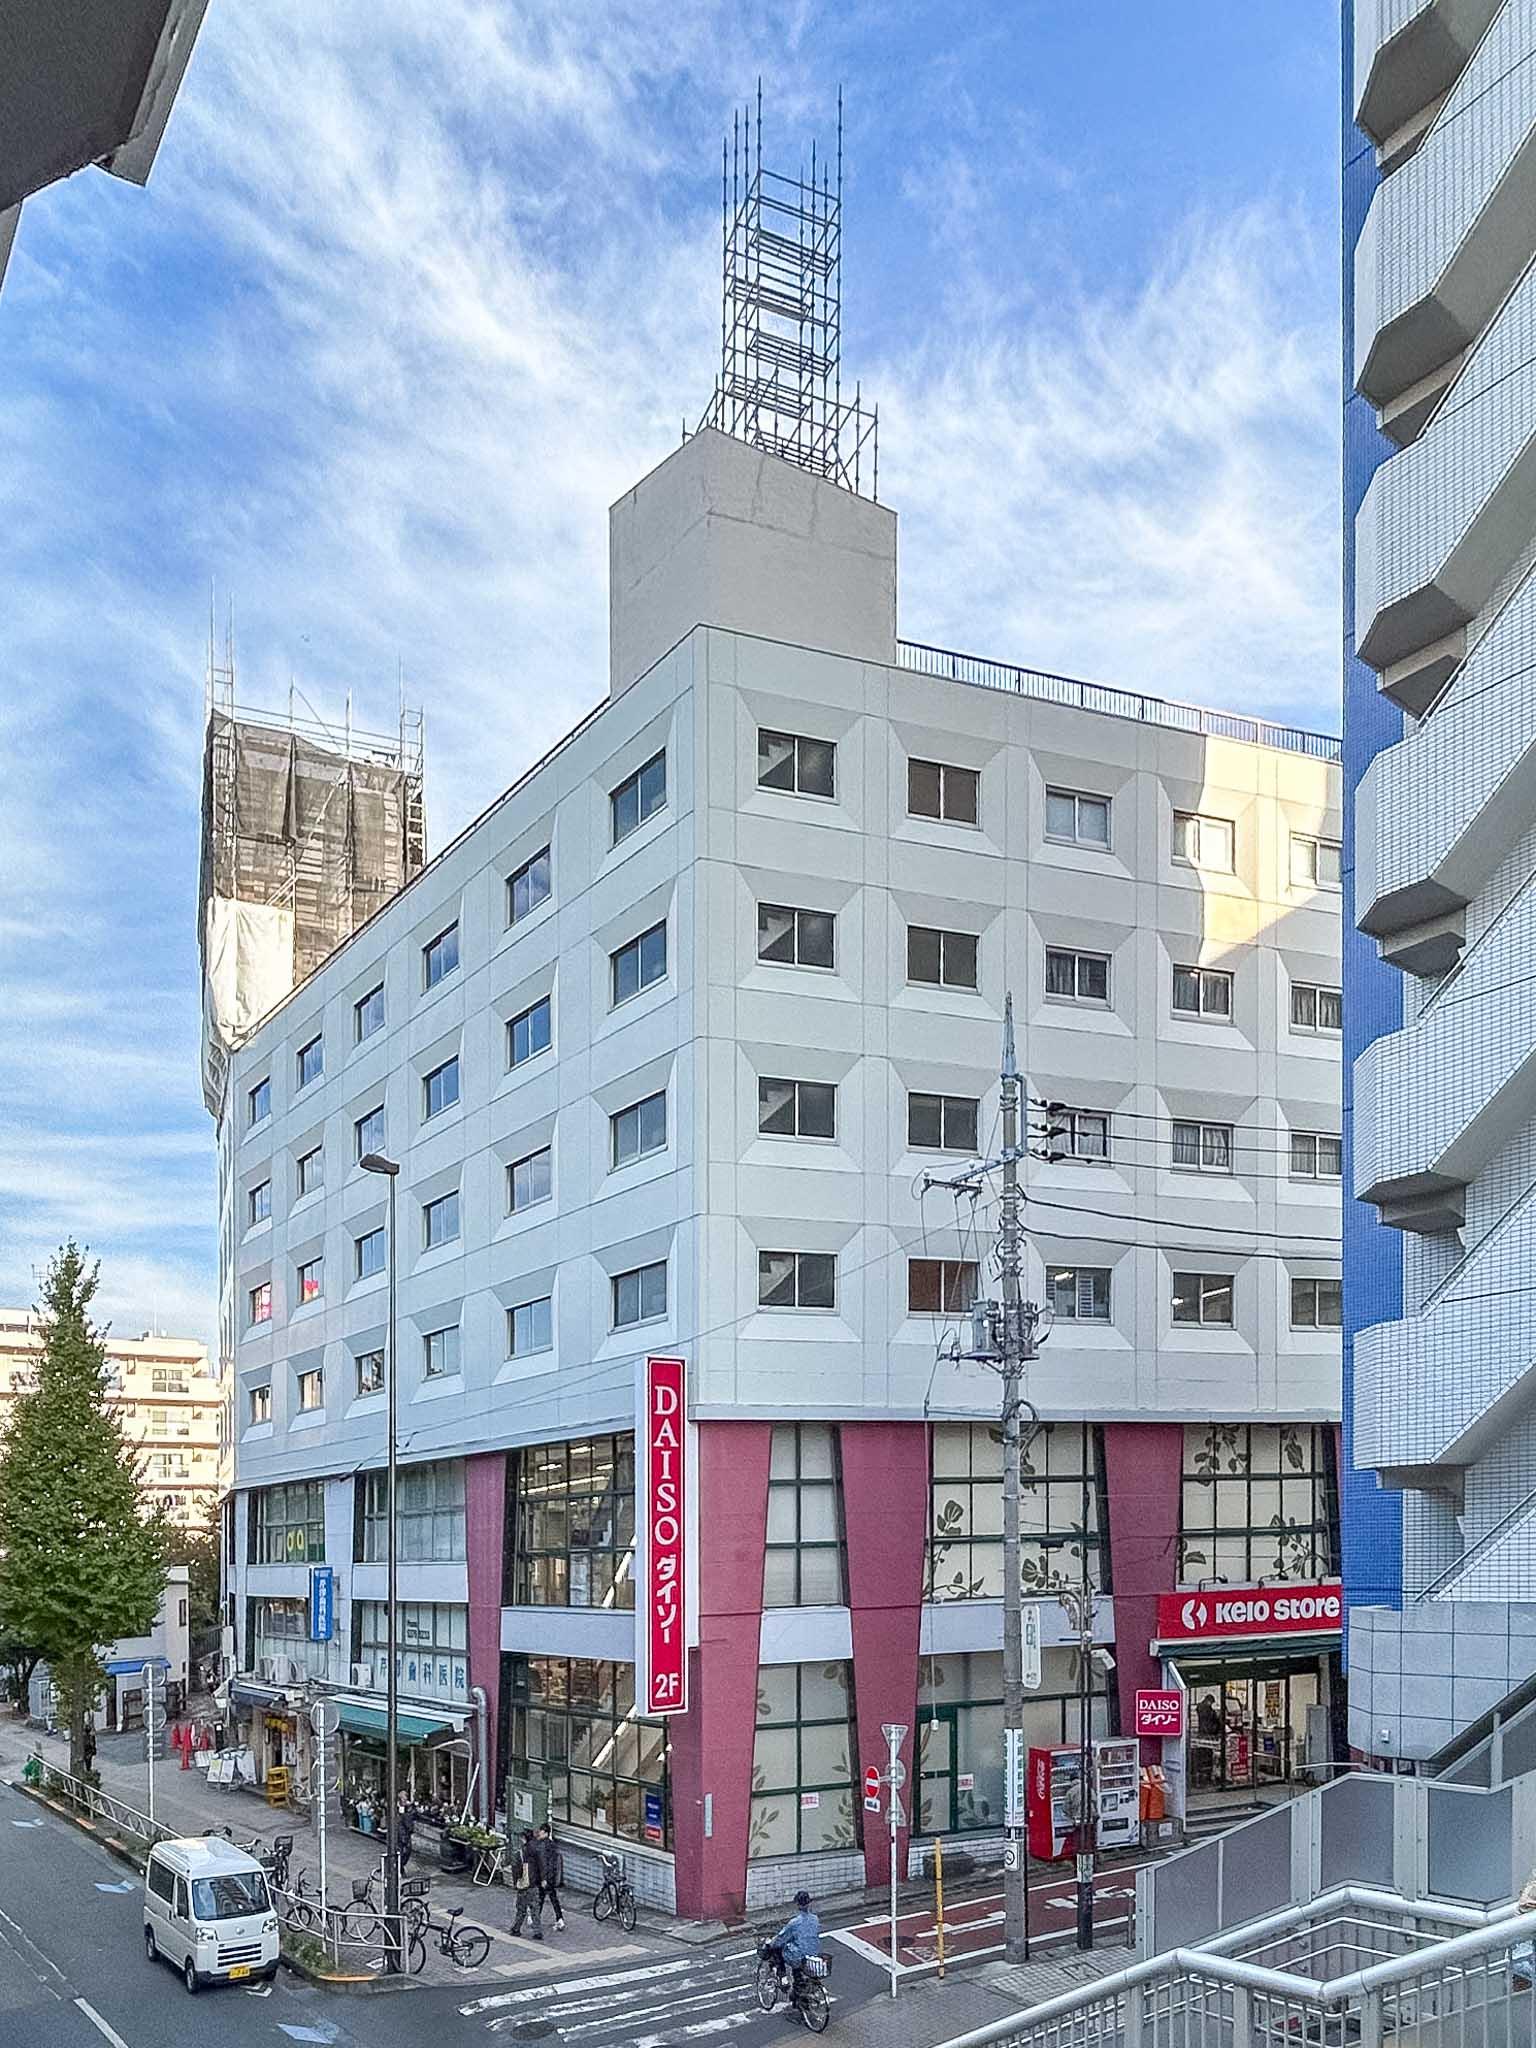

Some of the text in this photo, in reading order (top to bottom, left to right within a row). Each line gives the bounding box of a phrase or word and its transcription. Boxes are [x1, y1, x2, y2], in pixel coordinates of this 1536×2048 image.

[653, 1385, 679, 1546] DAISO
[656, 1554, 677, 1644] ダイソー
[655, 1672, 679, 1698] 2F
[1139, 1699, 1179, 1711] DAISO
[1140, 1713, 1178, 1726] ダイソー
